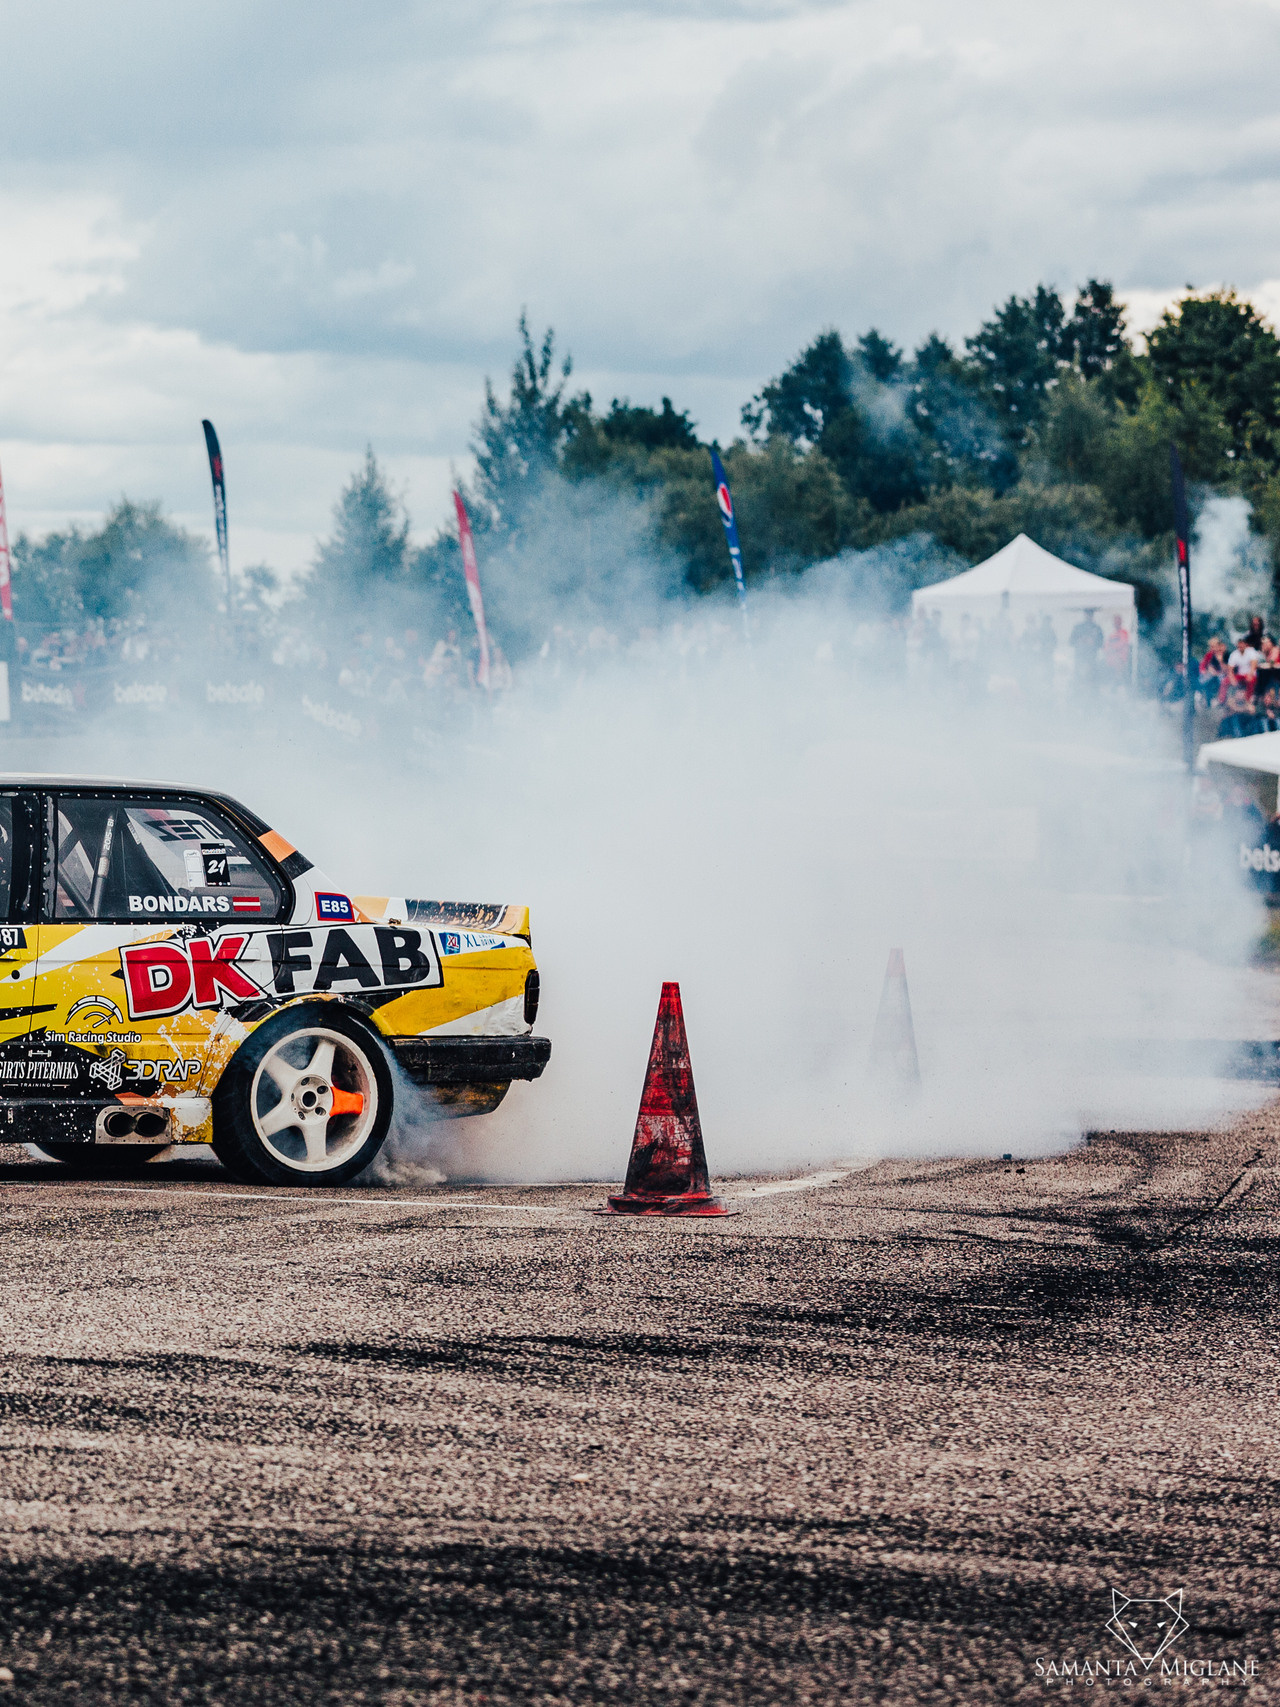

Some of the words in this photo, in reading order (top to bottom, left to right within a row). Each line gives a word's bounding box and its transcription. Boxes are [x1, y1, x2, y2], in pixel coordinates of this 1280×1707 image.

[1240, 843, 1280, 872] bets
[207, 859, 226, 876] 21
[128, 895, 230, 912] BONDARS
[320, 899, 350, 914] E85
[1, 928, 20, 947] 87
[447, 935, 460, 948] XL
[463, 934, 481, 948] XL
[122, 934, 265, 1015] DK
[266, 926, 431, 994] FAB
[44, 1031, 65, 1042] Sim
[67, 1031, 105, 1045] Racing
[106, 1031, 142, 1043] Studio
[26, 1061, 79, 1080] PITERNIKS
[125, 1059, 202, 1082] 3DRAP
